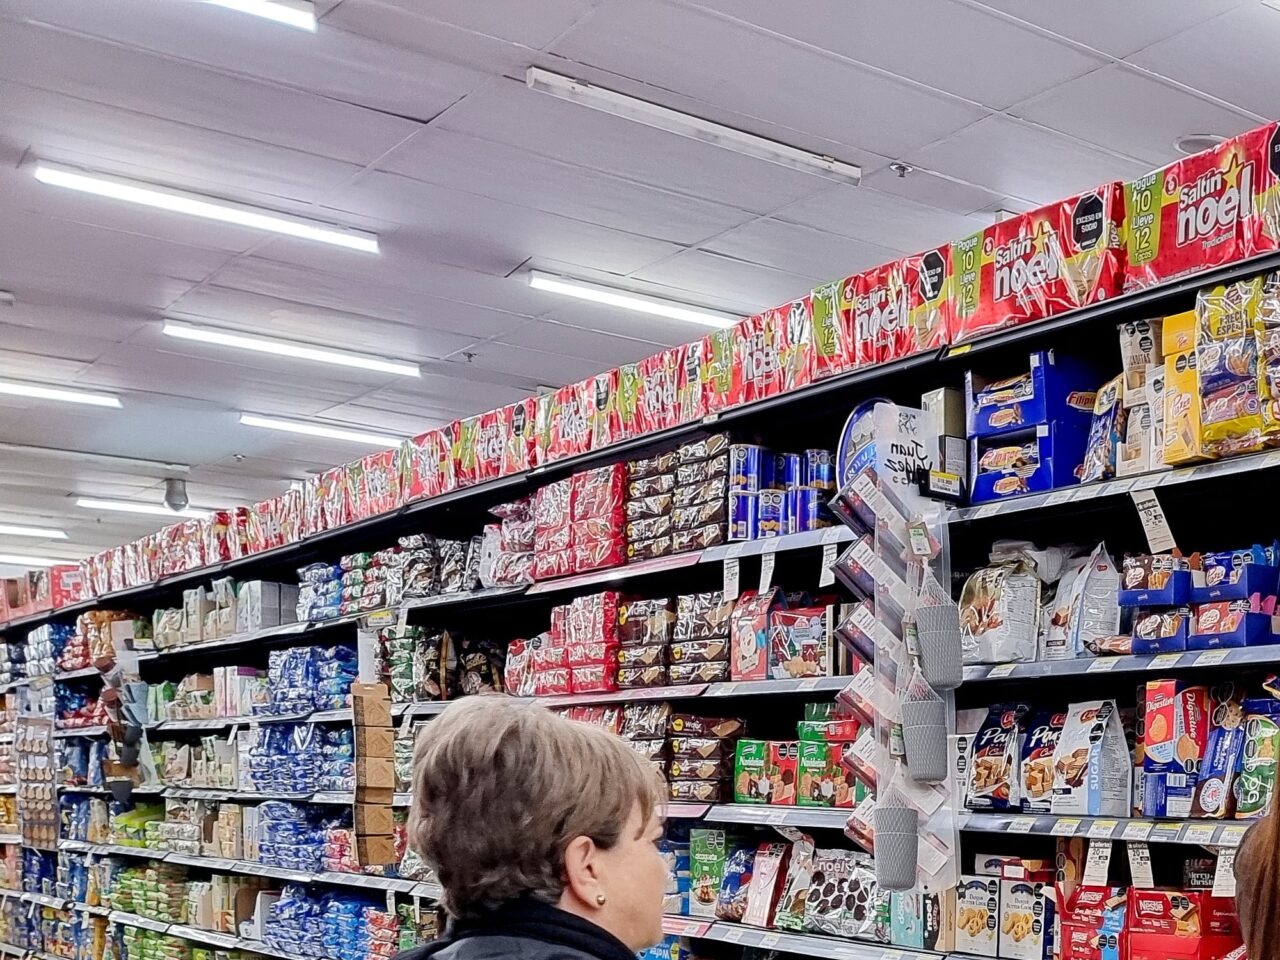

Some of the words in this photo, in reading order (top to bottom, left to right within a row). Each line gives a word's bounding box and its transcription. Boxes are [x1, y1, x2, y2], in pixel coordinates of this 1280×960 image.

[1135, 191, 1151, 213] 10
[1177, 164, 1254, 246] noel
[1132, 214, 1154, 228] Lleve
[1135, 229, 1151, 250] 12
[962, 251, 974, 270] 10
[994, 231, 1059, 301] noel
[962, 286, 973, 303] 12
[1090, 748, 1100, 791] SUGAR
[818, 860, 845, 873] noel
